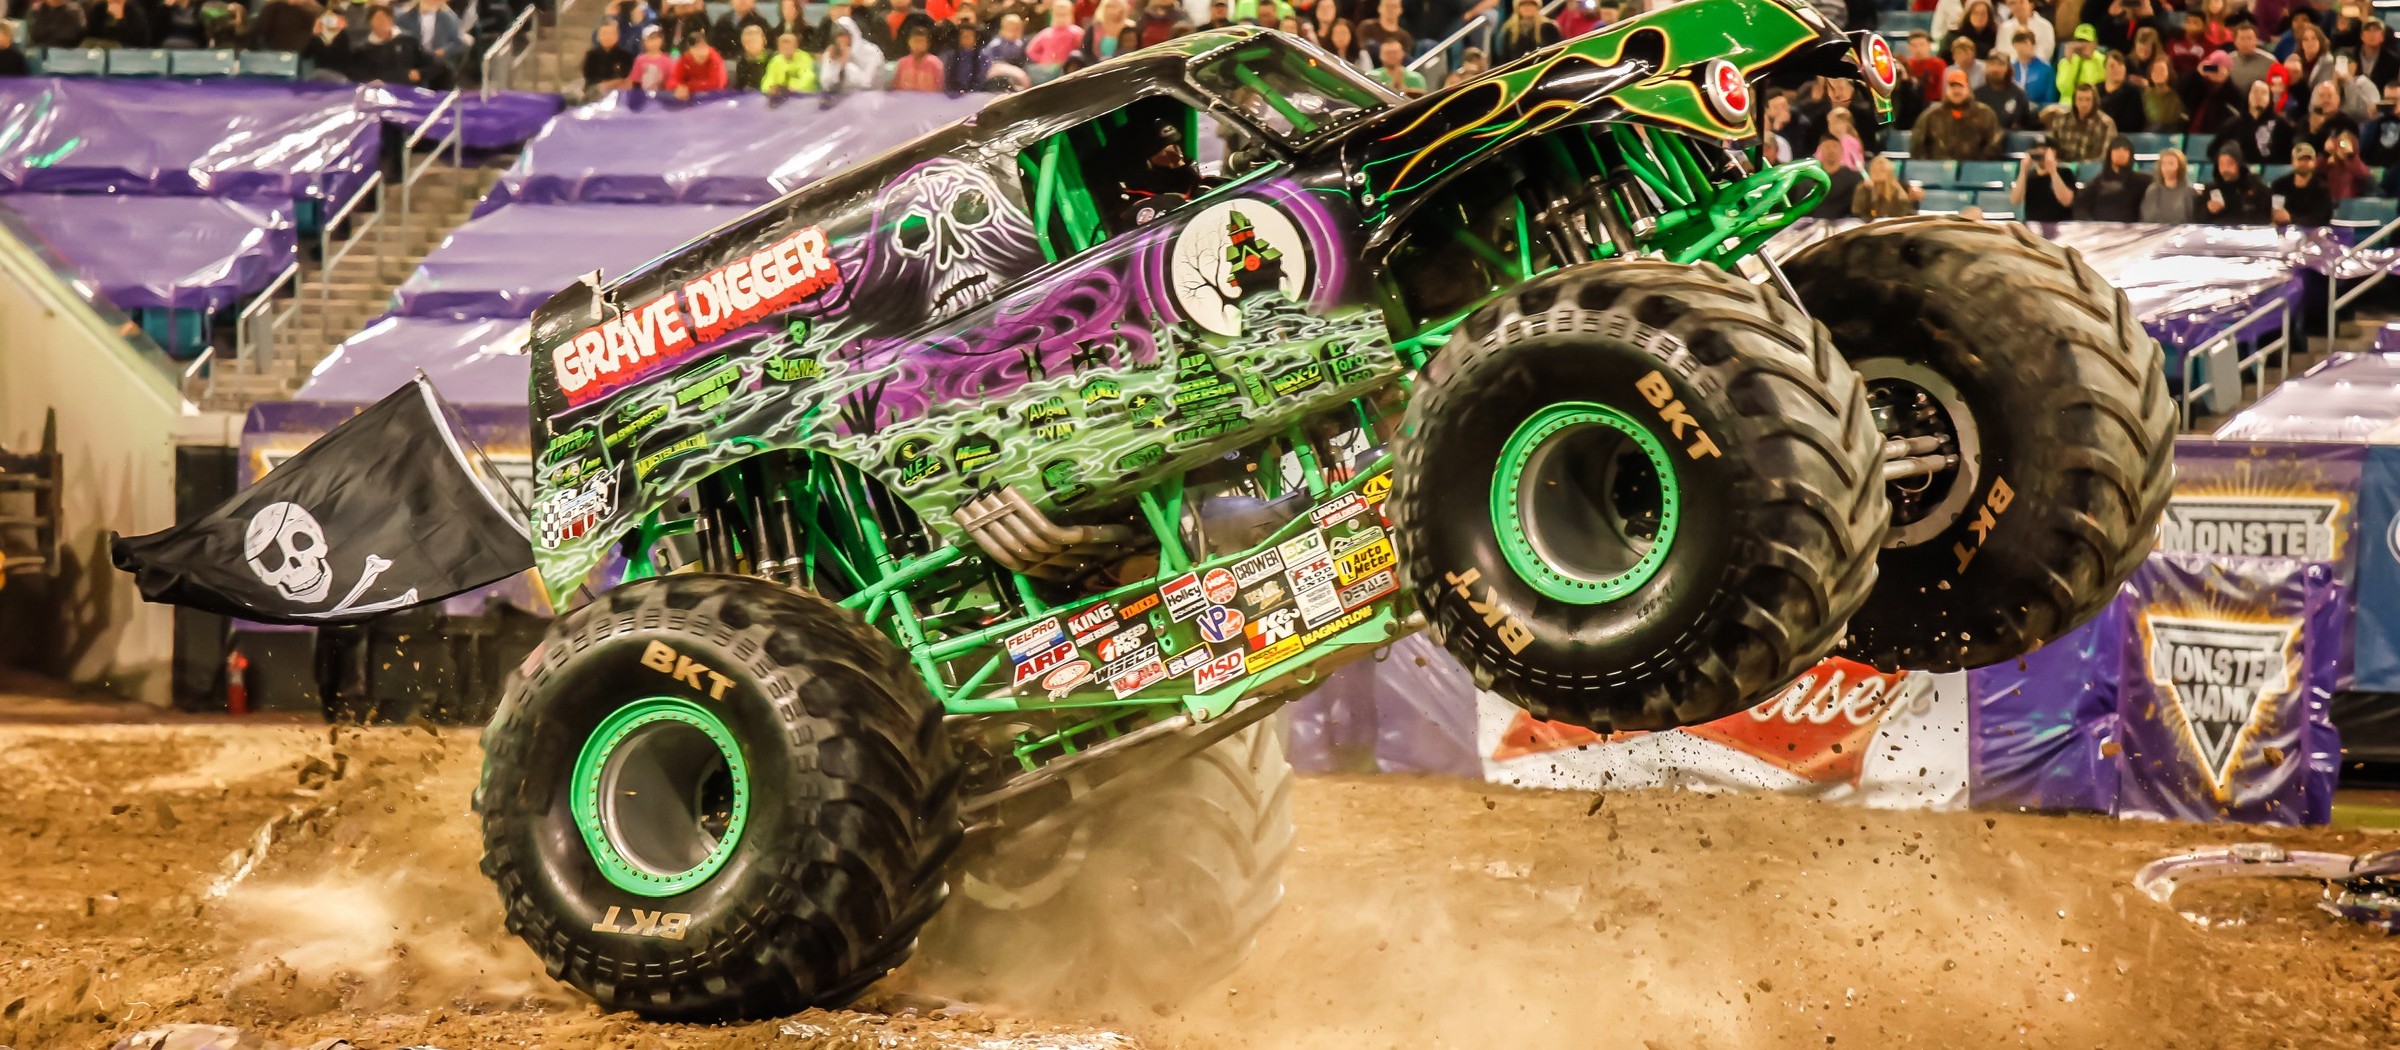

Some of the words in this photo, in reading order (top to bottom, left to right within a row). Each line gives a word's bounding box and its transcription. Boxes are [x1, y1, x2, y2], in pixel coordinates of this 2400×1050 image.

[552, 294, 688, 393] GRAVE
[684, 226, 832, 329] DIGGER
[1180, 354, 1206, 370] RIP
[1270, 362, 1320, 392] MAX-D
[1635, 370, 1722, 460] BKT
[1312, 494, 1356, 521] LINCOLN
[1953, 475, 2015, 575] BKT
[2163, 519, 2331, 560] MONSTER
[1235, 549, 1279, 581] CROWER
[1354, 545, 1382, 565] Auto
[1355, 552, 1391, 574] Meter
[1297, 572, 1335, 592] ENDS
[1302, 567, 1332, 583] ROD
[1343, 573, 1390, 602] DERALE
[1167, 585, 1202, 606] Holley
[1445, 567, 1536, 655] BKT
[1009, 620, 1056, 649] FEL-PRO
[1068, 604, 1115, 636] KING
[1112, 623, 1148, 644] SPEED
[1199, 607, 1226, 640] VP
[1257, 608, 1301, 646] K&N
[1301, 605, 1373, 646] MAGNAFLOW
[1017, 642, 1073, 682] ARP
[1114, 637, 1142, 657] PRO
[640, 640, 737, 700] BKT
[1198, 652, 1242, 685] MSD
[2180, 683, 2252, 723] JAM
[591, 906, 691, 941] BKT
